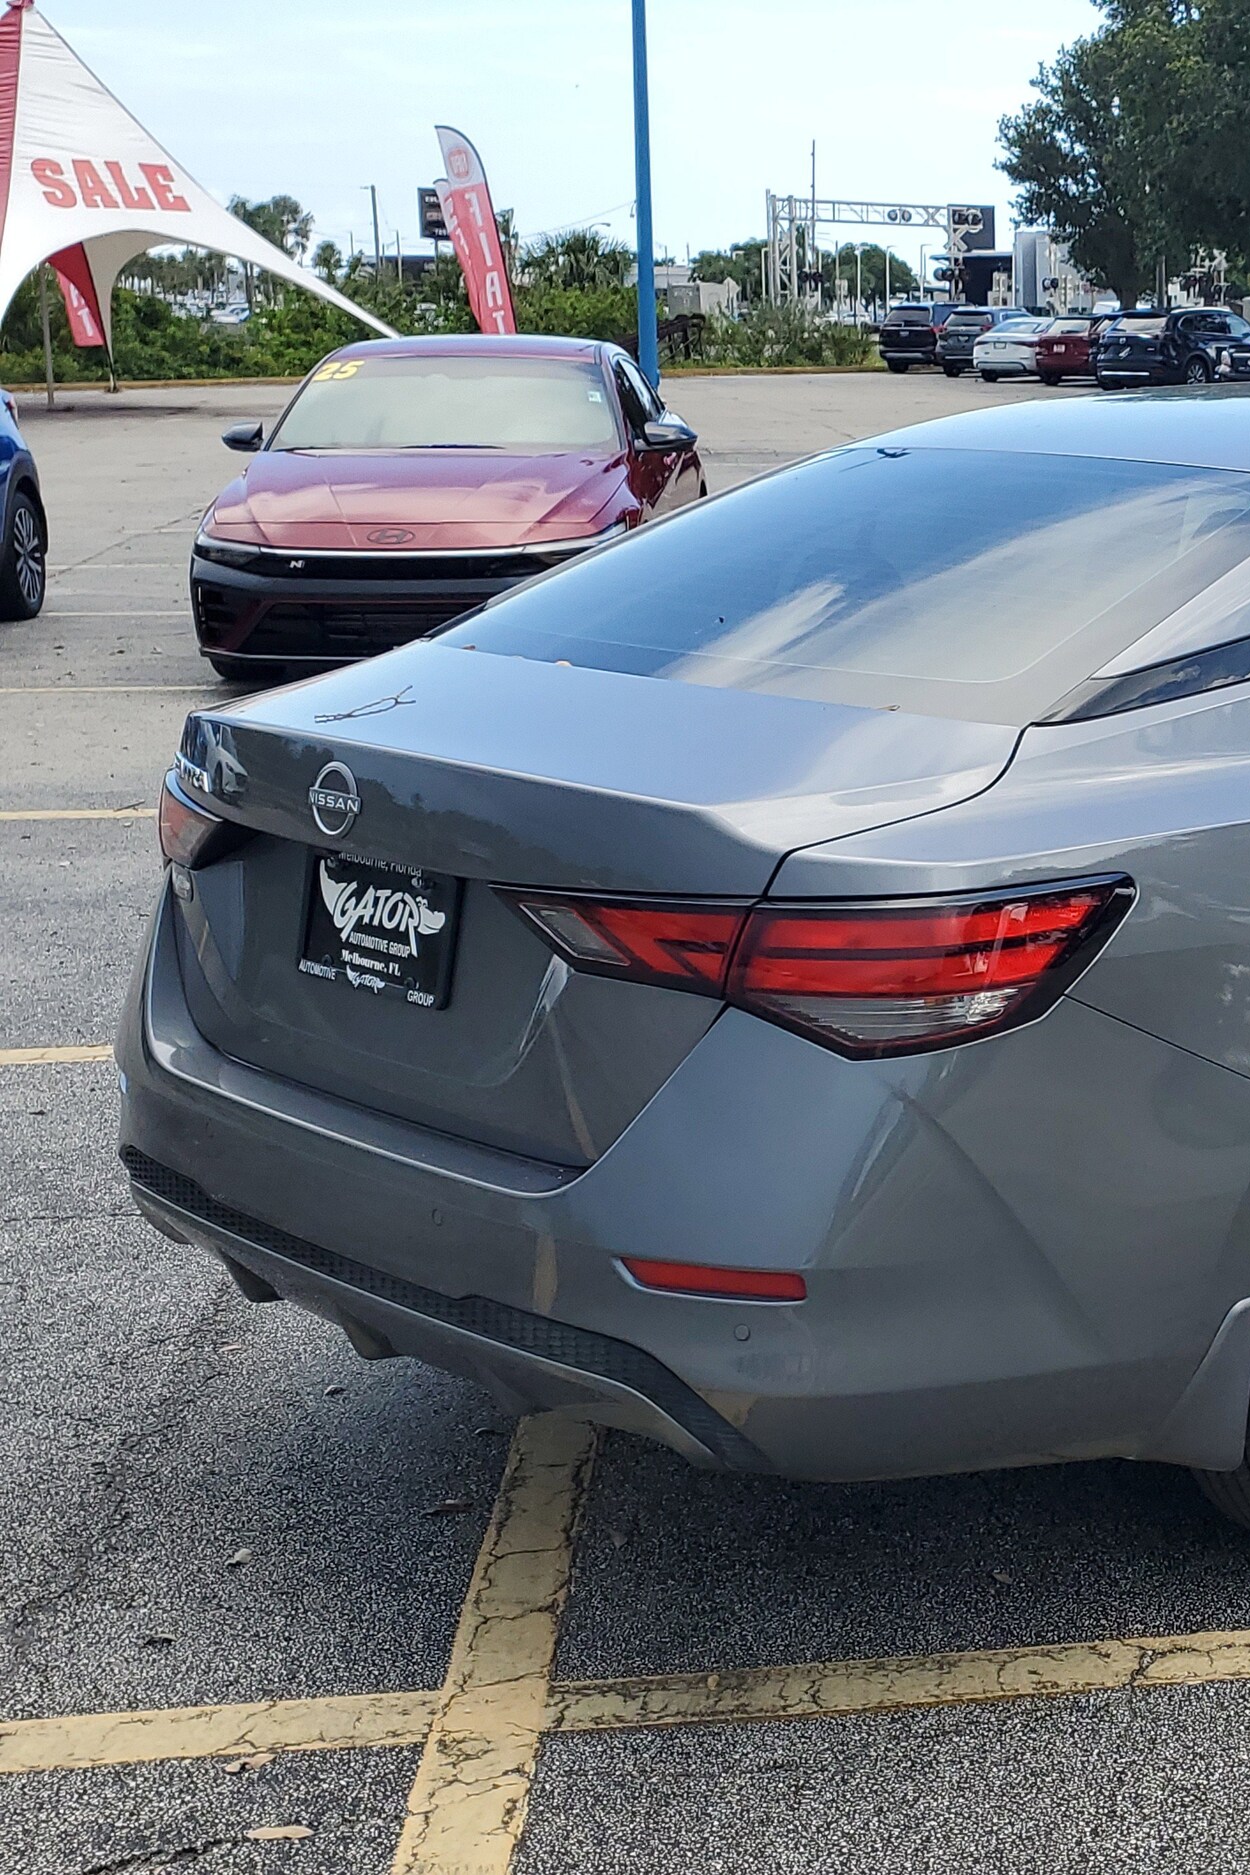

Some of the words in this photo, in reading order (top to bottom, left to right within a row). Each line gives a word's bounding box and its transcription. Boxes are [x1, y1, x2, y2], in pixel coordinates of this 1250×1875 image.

[30, 158, 192, 212] SALE
[312, 361, 365, 381] 25
[309, 792, 358, 812] NISSAN
[333, 881, 418, 957] GATOR
[348, 931, 389, 953] AUTOMOTIVE
[388, 941, 411, 958] GROUP
[298, 959, 337, 980] AUTOMOTIVE
[340, 949, 388, 973] Melbourne,
[388, 962, 402, 976] FL
[407, 990, 435, 1007] GROUP
